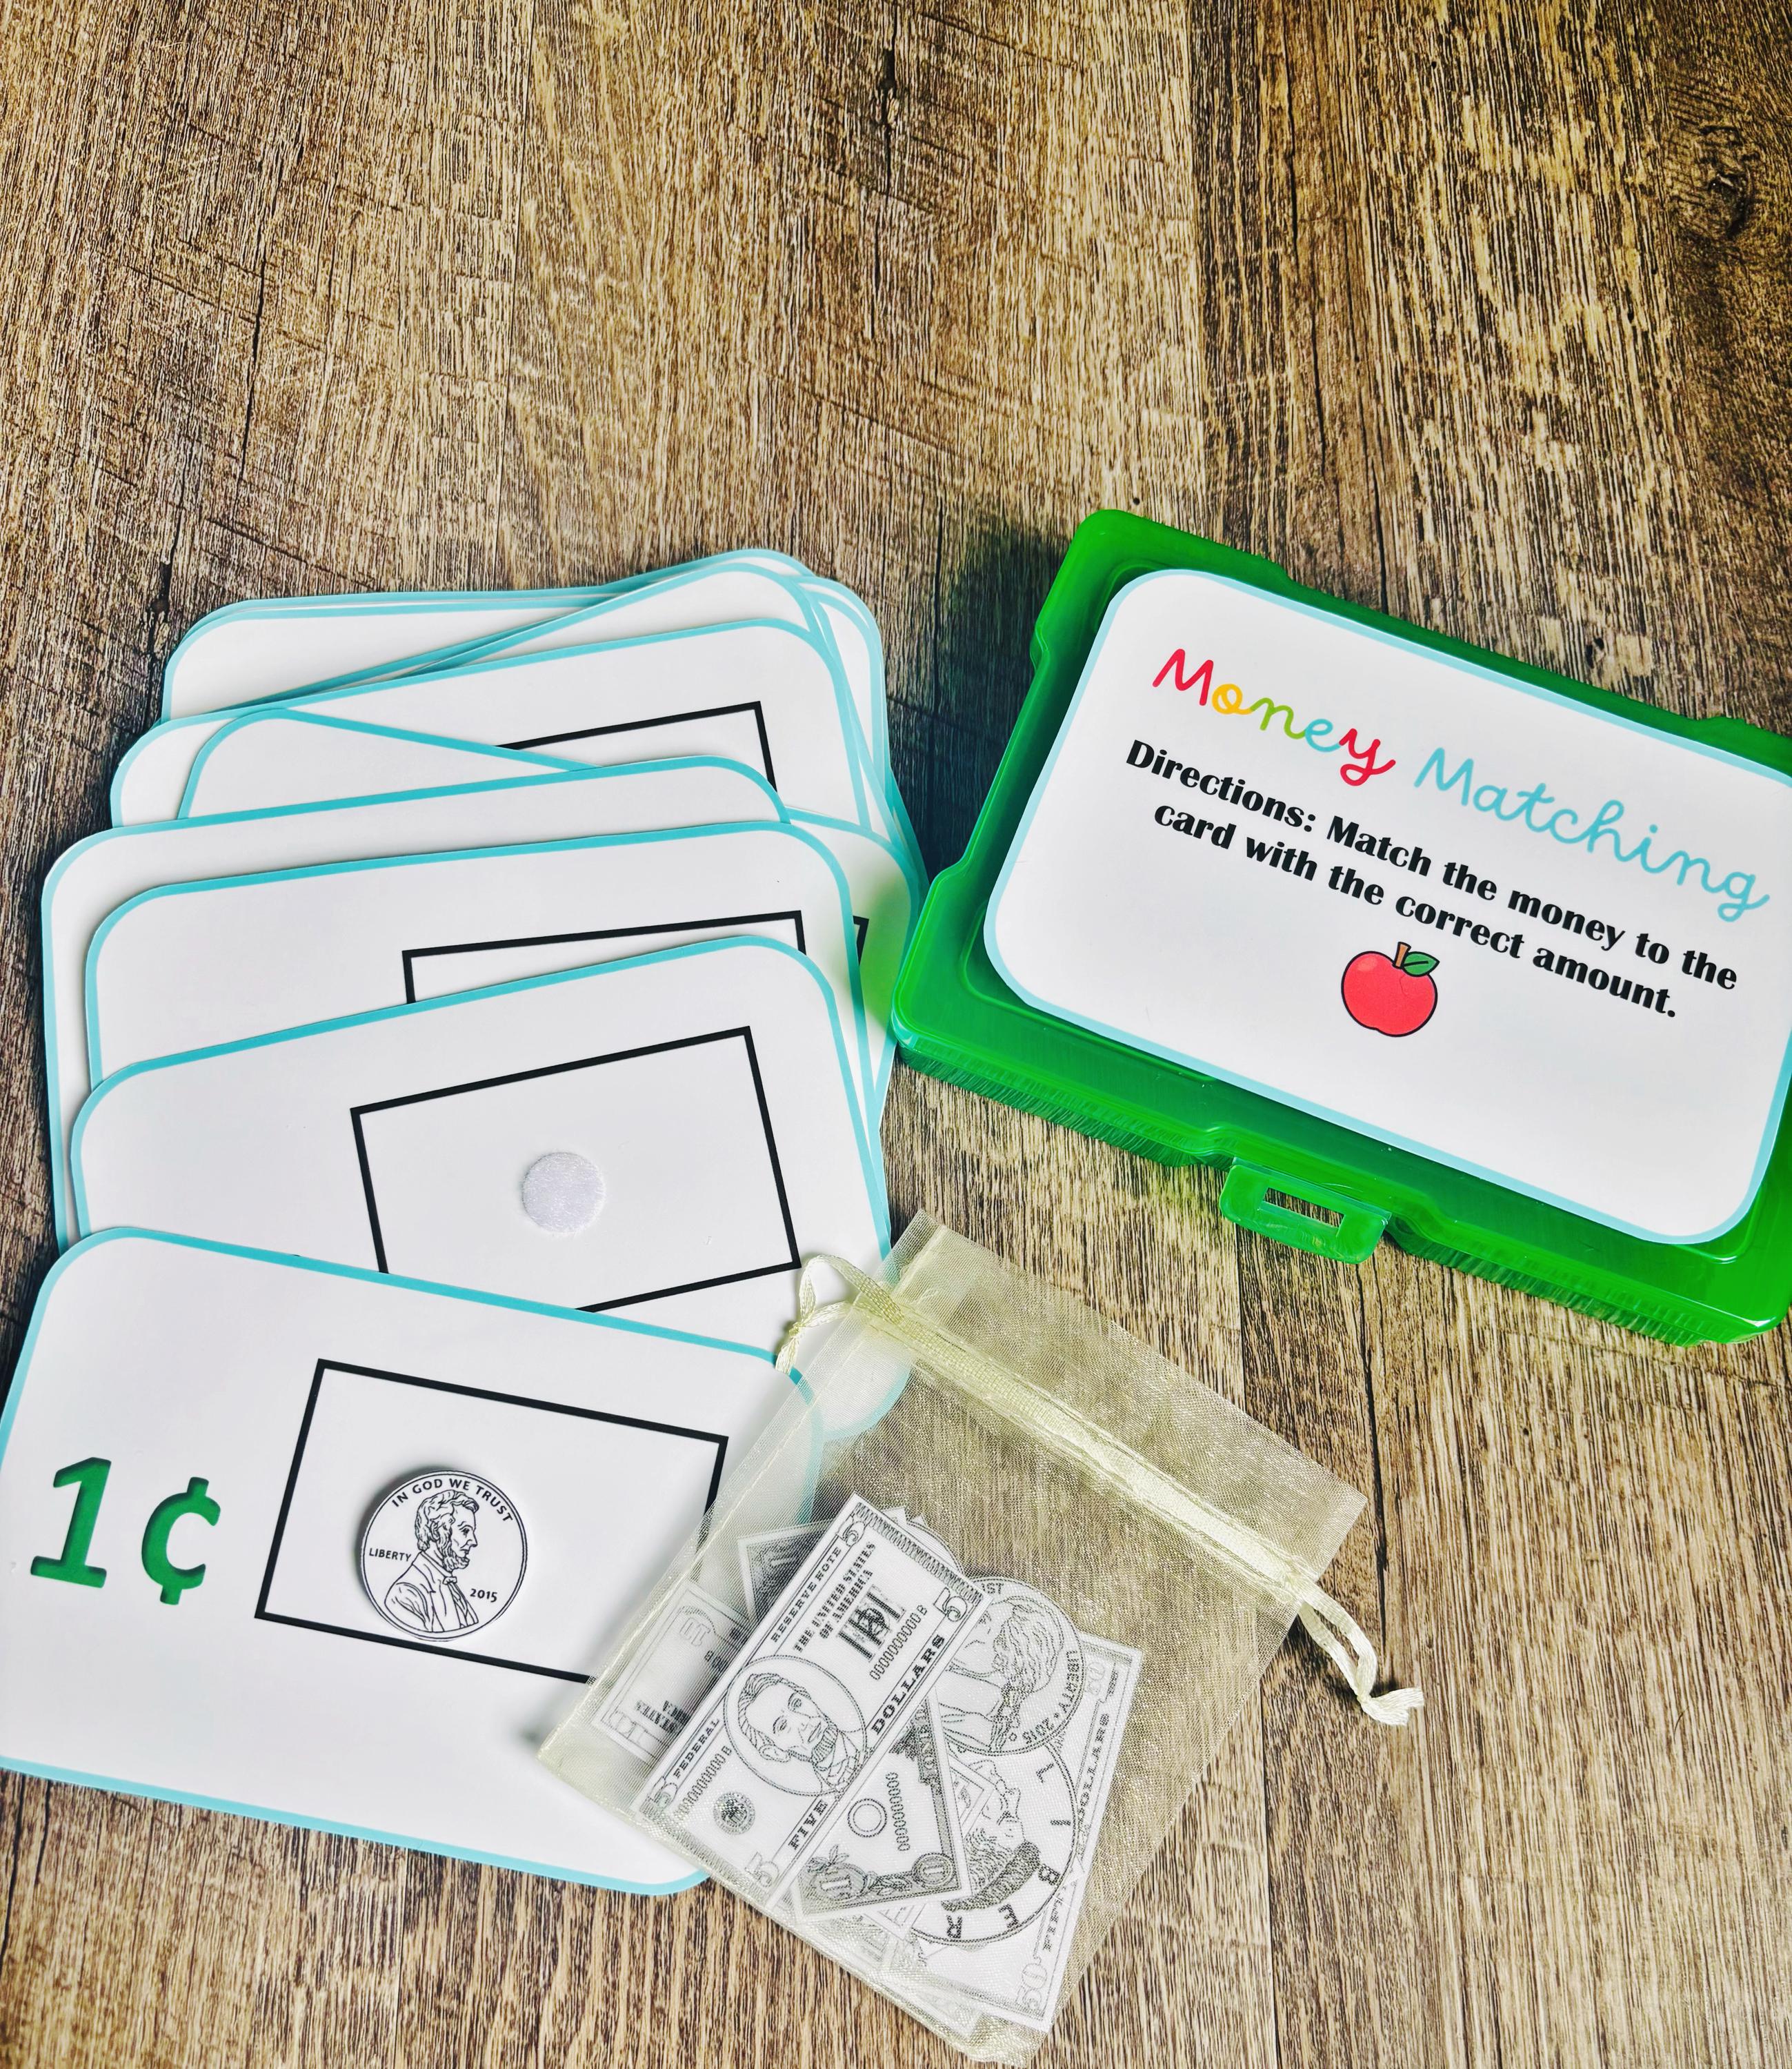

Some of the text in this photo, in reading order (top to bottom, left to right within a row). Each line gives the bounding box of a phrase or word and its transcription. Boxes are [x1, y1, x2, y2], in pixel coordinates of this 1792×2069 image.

[1153, 649, 1770, 922] Money Matching
[1126, 740, 1736, 989] Directions: Match the money to the
[1155, 806, 1675, 1017] card with the correct amount.
[392, 1478, 512, 1521] IN GOD WE TRUST
[369, 1548, 411, 1561] LIBERTY
[470, 1589, 497, 1603] 2015
[792, 1541, 876, 1654] THE UNITED STATES
[830, 1567, 873, 1623] AMERICA
[930, 1586, 971, 1625] 5
[673, 1546, 842, 1779] FEDERAL RESERVE NOTE
[1059, 1650, 1080, 1714] LIBERTY
[788, 1634, 945, 1850] FIVE DOLLARS
